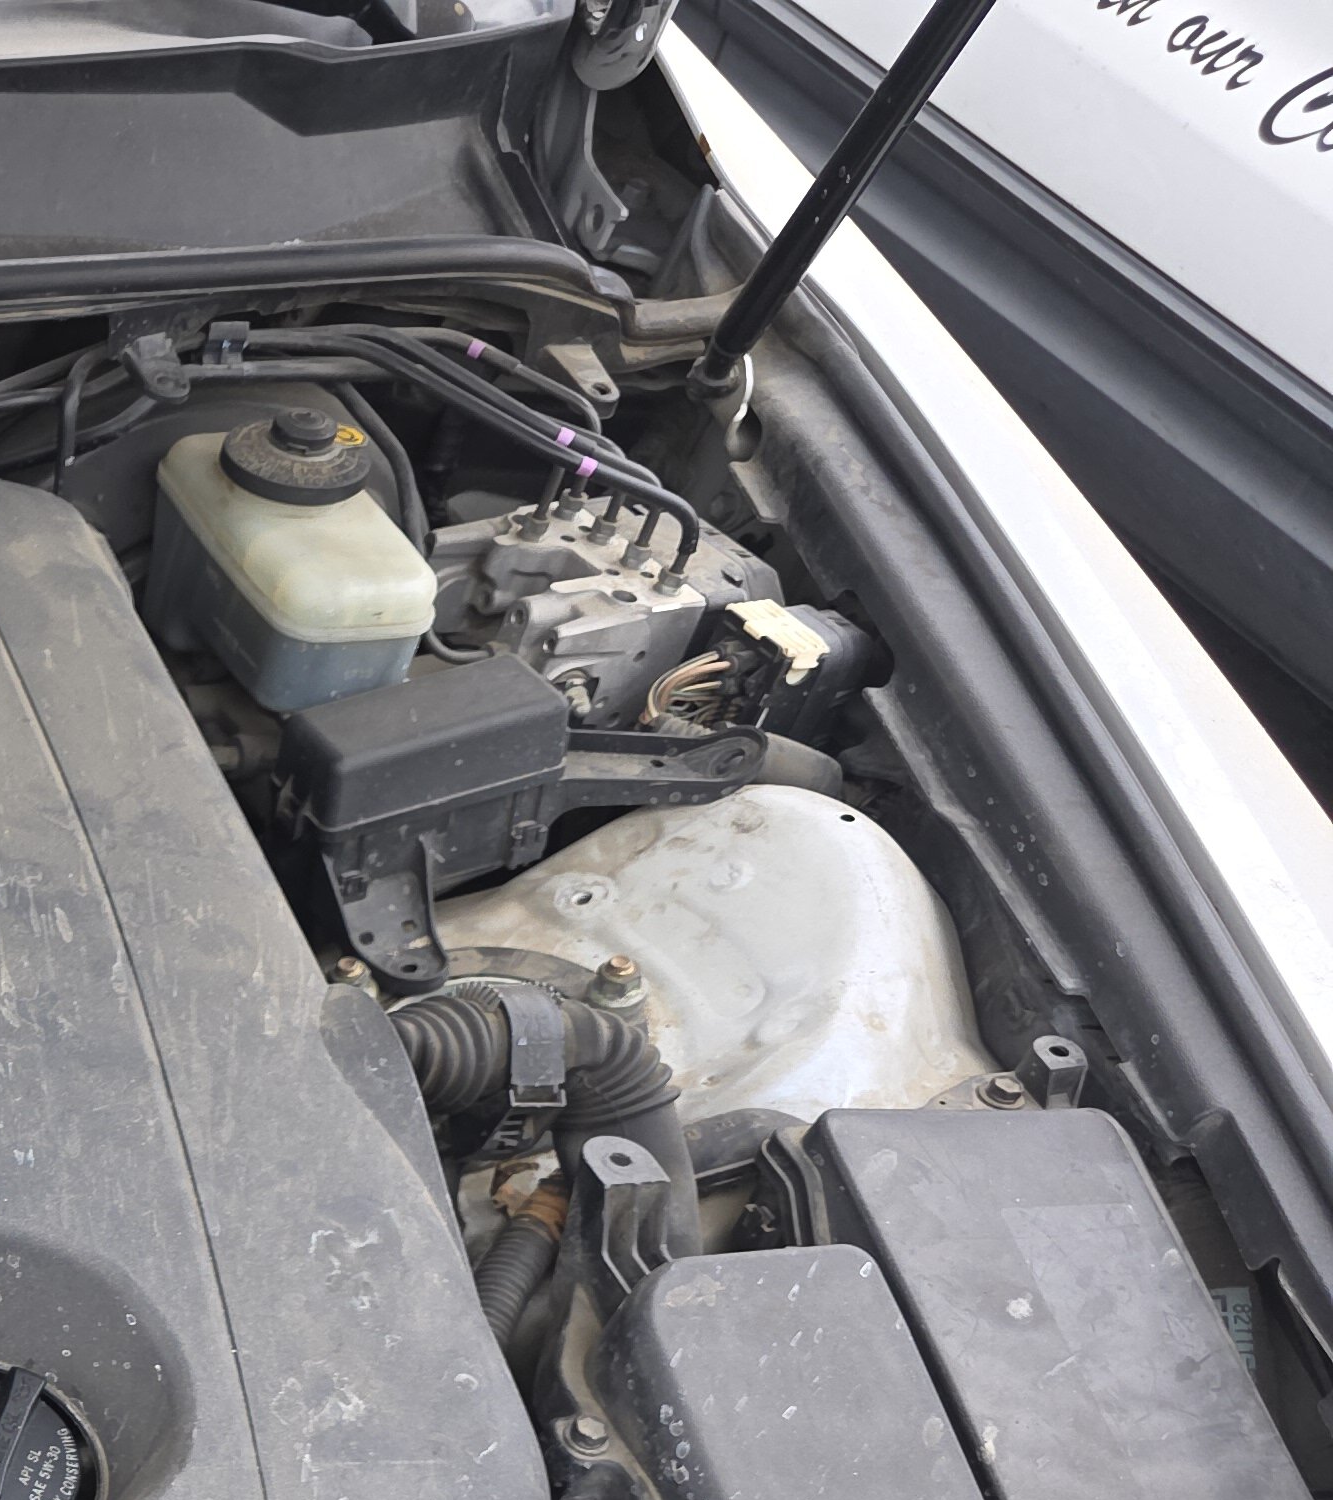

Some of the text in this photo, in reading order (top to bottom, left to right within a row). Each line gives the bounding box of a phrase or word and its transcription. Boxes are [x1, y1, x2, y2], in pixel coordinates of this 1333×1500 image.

[1167, 15, 1264, 91] our
[18, 1449, 41, 1486] API SL
[38, 1445, 61, 1480] 5W-30
[56, 1427, 80, 1496] CONSERVING
